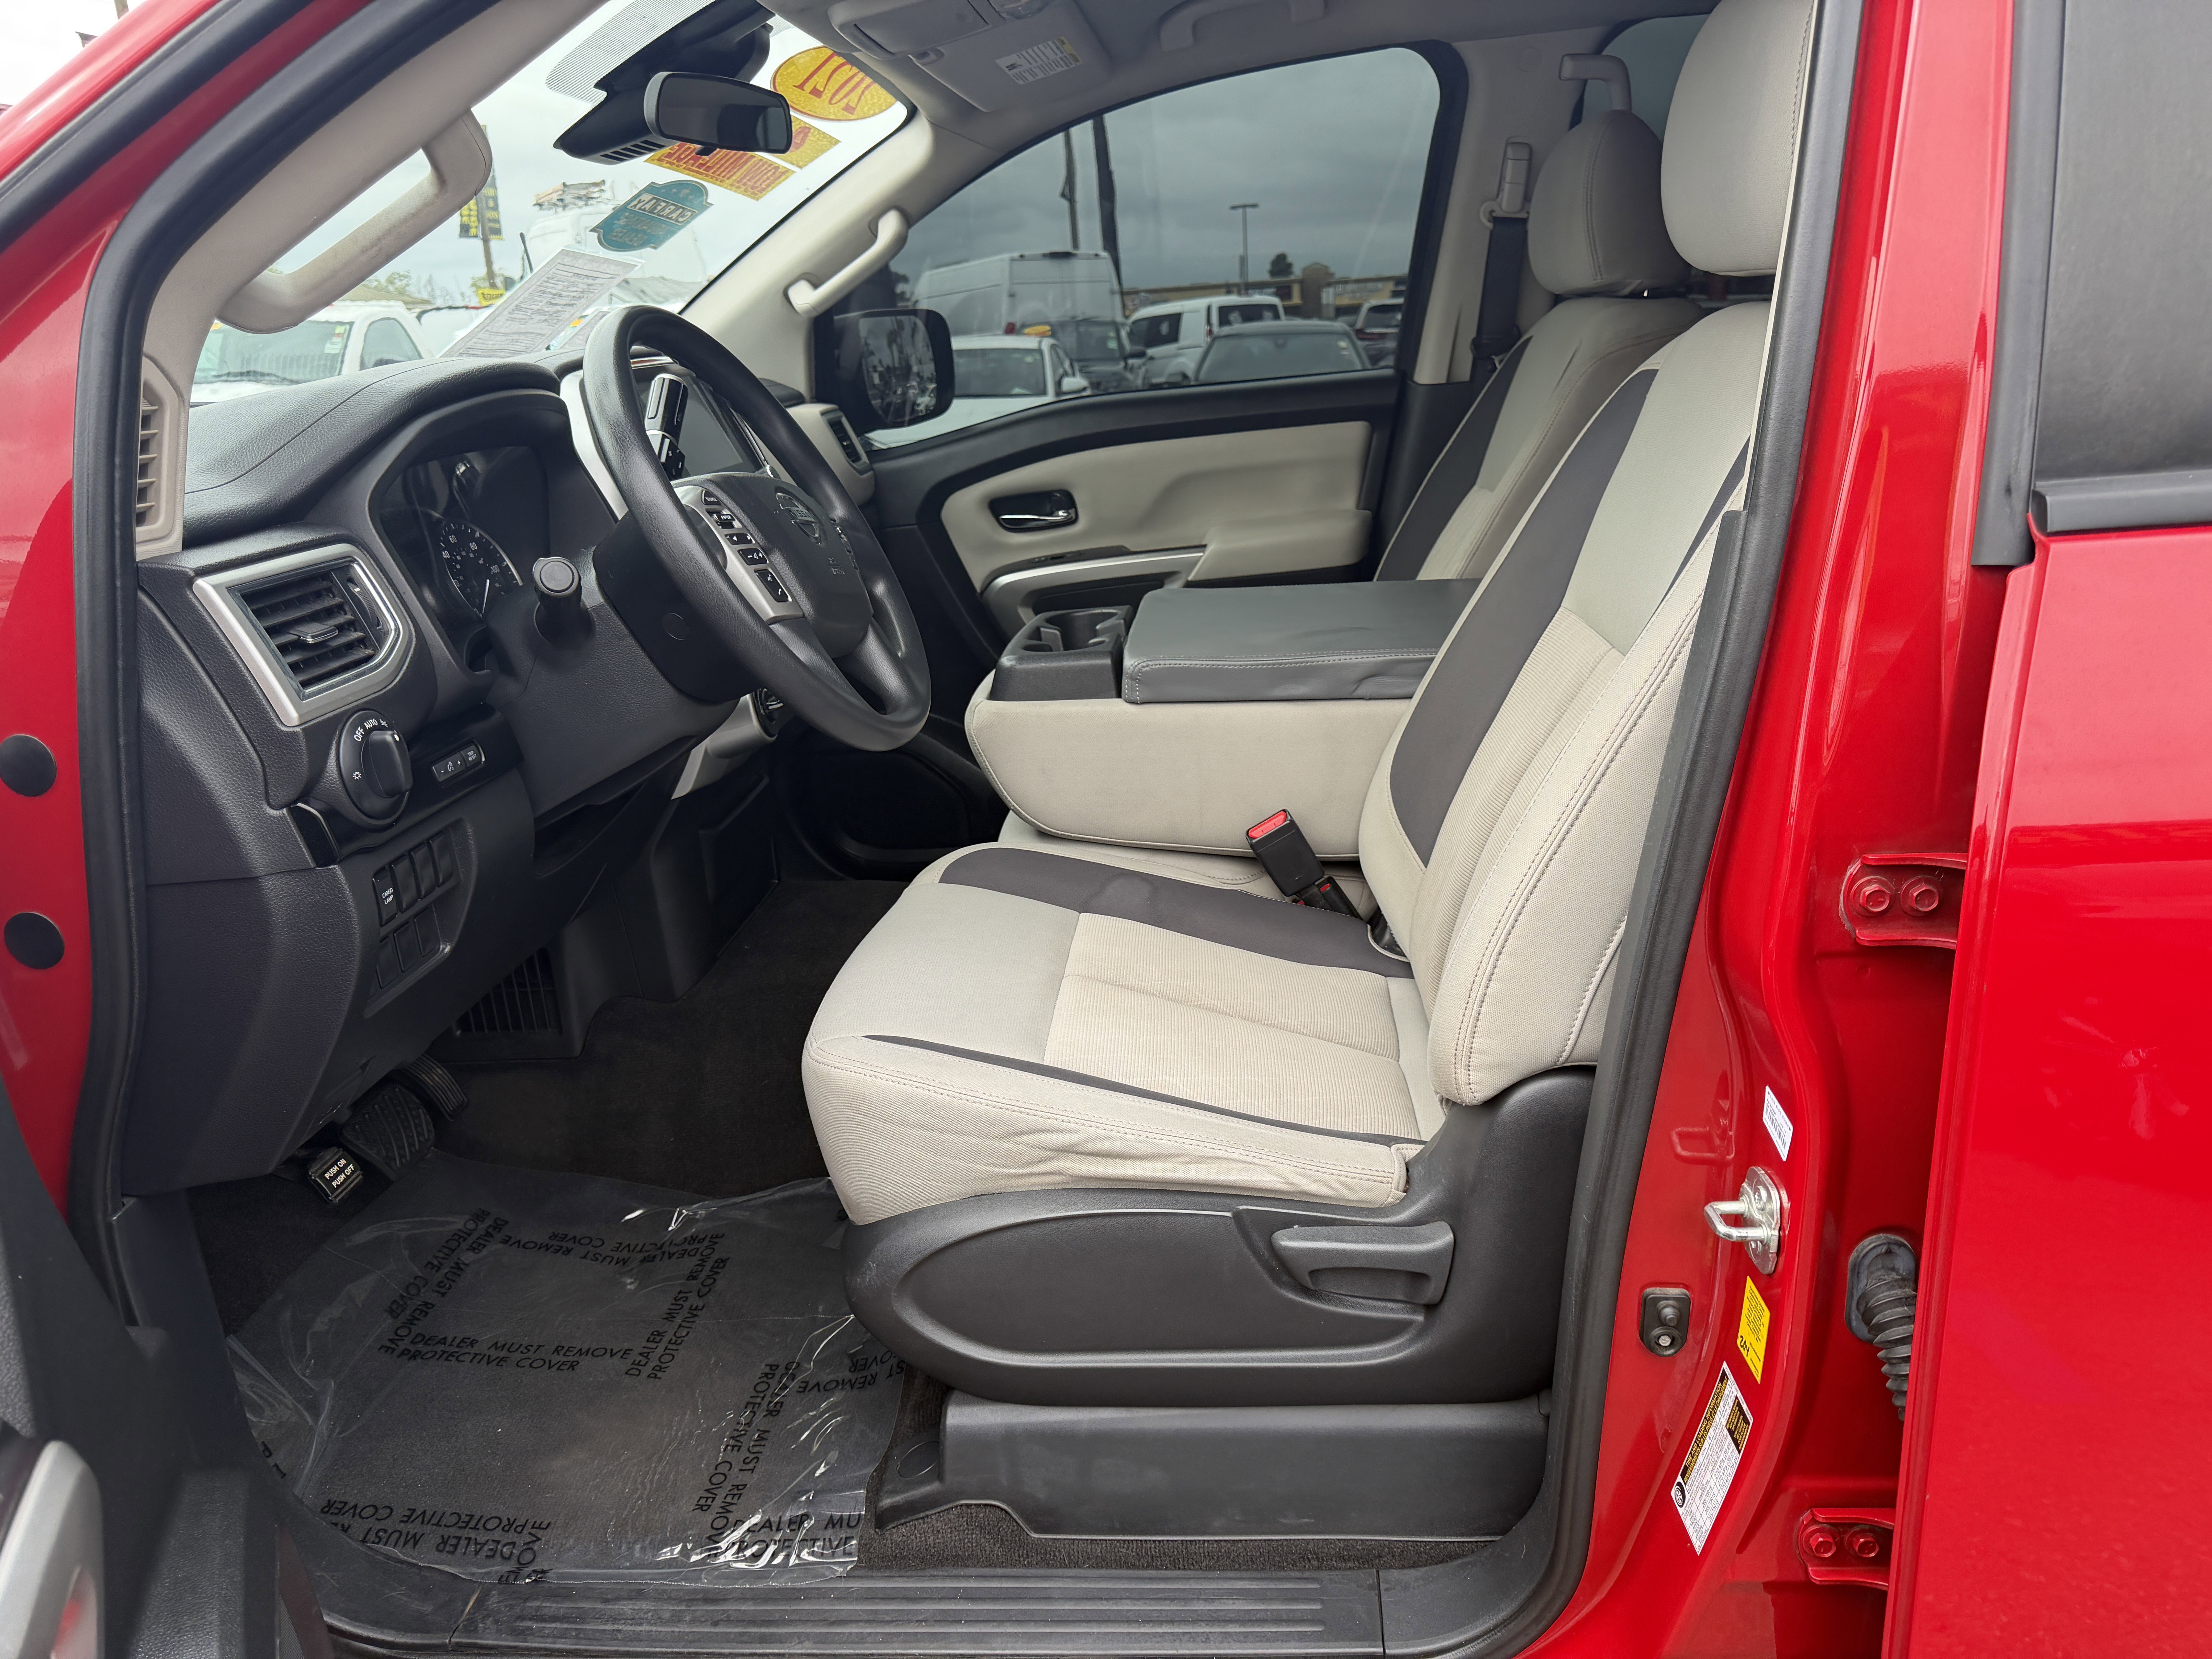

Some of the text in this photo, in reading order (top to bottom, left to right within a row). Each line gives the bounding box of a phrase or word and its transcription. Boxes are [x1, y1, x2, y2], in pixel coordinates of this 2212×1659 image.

[442, 550, 450, 559] 40
[354, 727, 364, 742] OFF
[364, 719, 378, 730] AUTO
[382, 888, 393, 898] CARGO
[384, 895, 393, 905] LAMP
[325, 1158, 347, 1180] PUSH ON
[332, 1164, 354, 1188] PUSH OFF
[499, 1234, 573, 1256] REMOVE
[548, 1231, 605, 1249] COVER
[384, 1208, 491, 1321] PROTECTIVE COVER
[579, 1250, 630, 1266] MUST
[378, 1217, 509, 1355] DEALER MUST REMOVE
[625, 1233, 725, 1378] DEALER MUST REMOVE
[647, 1257, 730, 1380] PROTECTIVE COVER
[410, 1333, 634, 1361] DEALER MUST REMOVE
[398, 1348, 580, 1372] PROTECTIVE COVER
[848, 1350, 898, 1374] OVER
[797, 1360, 905, 1394] ST REMOVE
[1696, 1417, 1707, 1444] LOADING
[1705, 1381, 1722, 1420] INFORMATION
[692, 1363, 776, 1513] PROTECTIVE COVER
[742, 1428, 771, 1474] MUST
[320, 1499, 529, 1534] PROTECTIVE COVER
[824, 1513, 862, 1530] MU
[359, 1527, 425, 1549] MUST
[435, 1534, 516, 1561] DEALER
